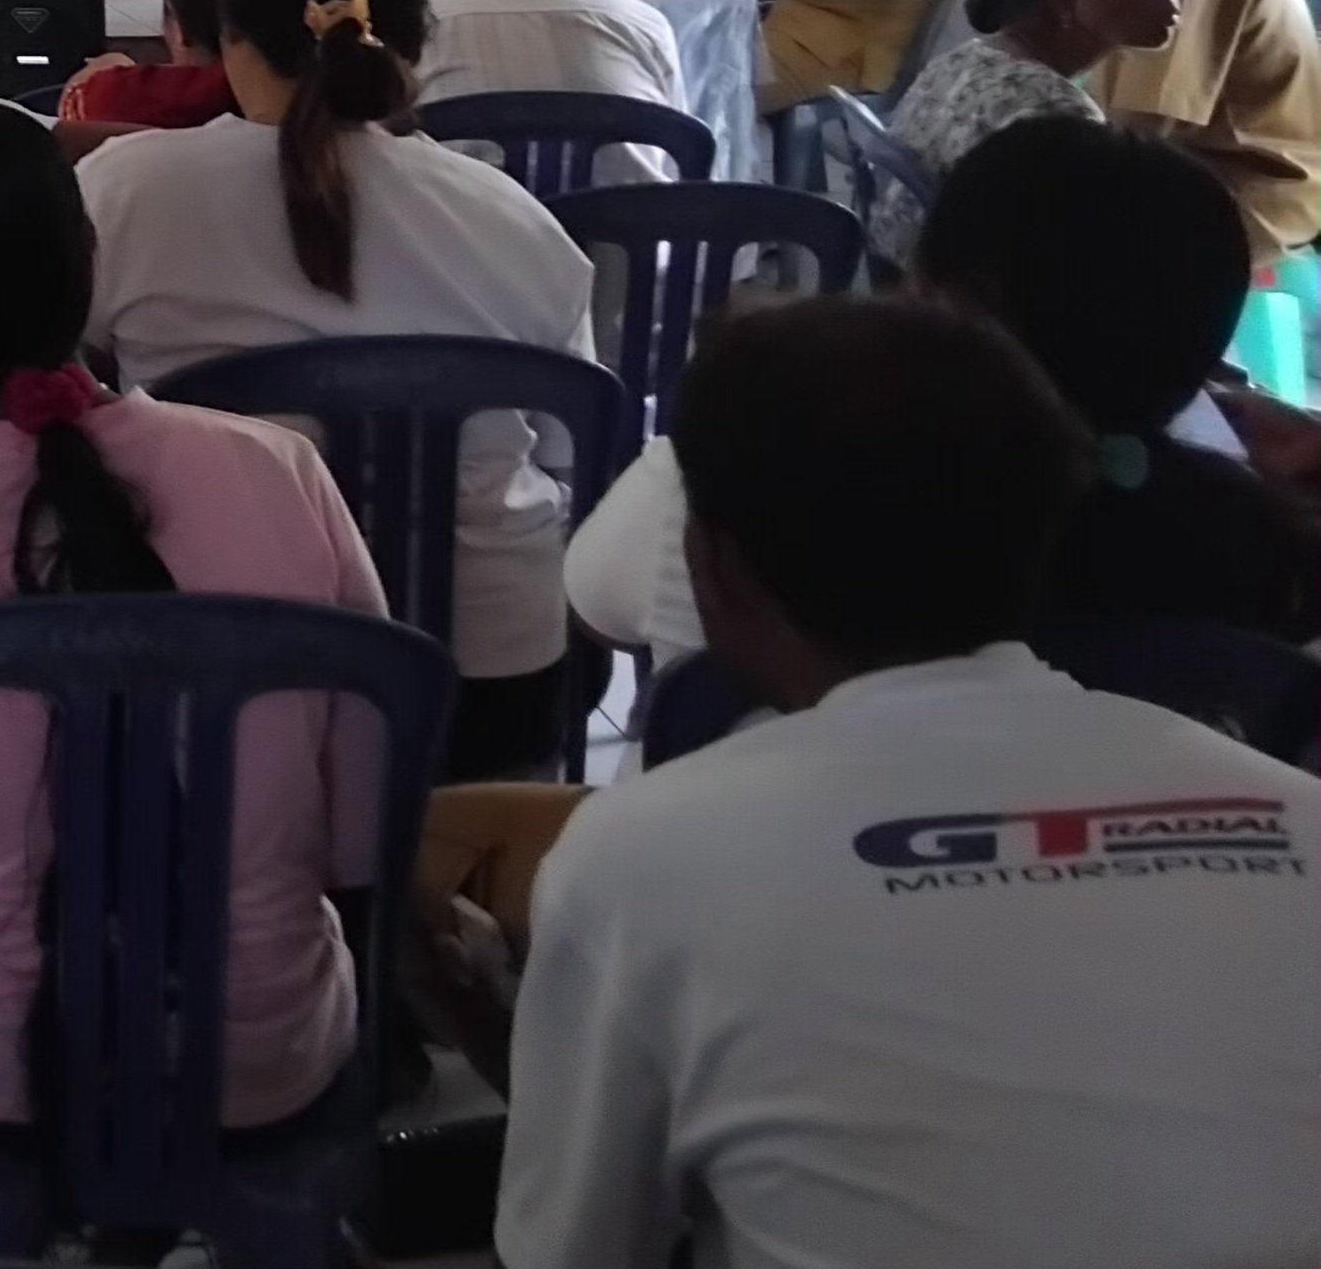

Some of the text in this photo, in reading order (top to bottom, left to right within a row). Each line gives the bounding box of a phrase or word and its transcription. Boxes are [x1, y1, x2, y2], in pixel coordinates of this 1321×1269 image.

[852, 811, 1287, 869] GT RADIAL
[884, 853, 1308, 896] MOTORSPORT
